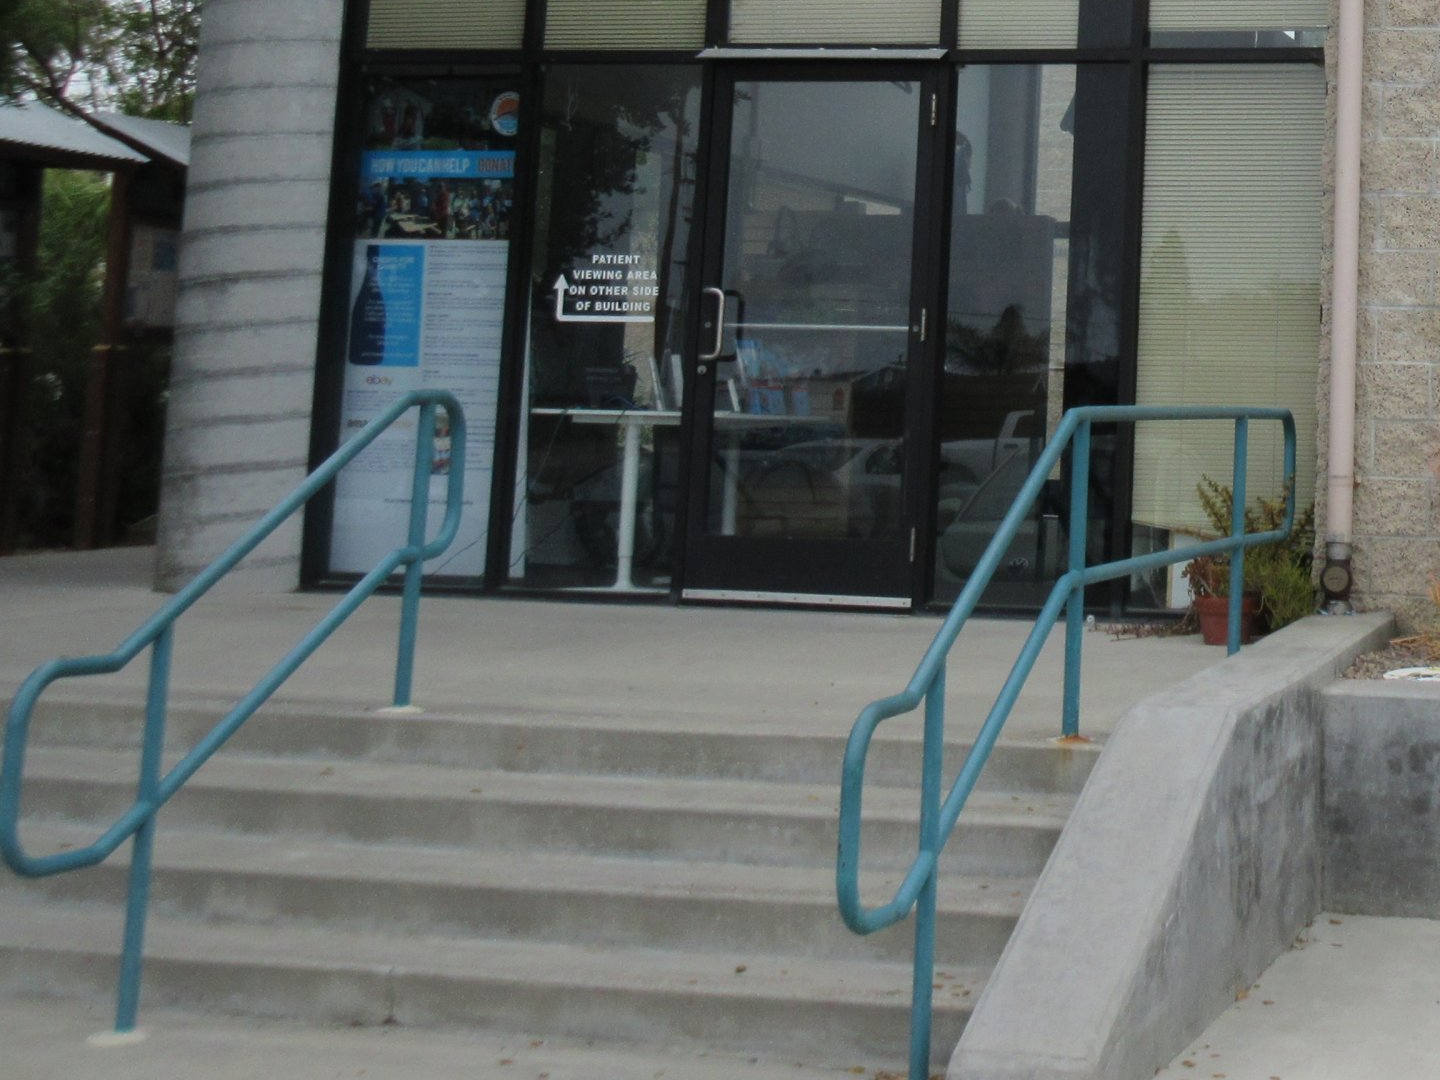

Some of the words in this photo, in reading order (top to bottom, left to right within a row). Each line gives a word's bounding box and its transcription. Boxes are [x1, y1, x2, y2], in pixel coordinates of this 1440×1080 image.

[592, 254, 641, 264] PATIENT
[573, 270, 623, 280] VIEWING
[627, 270, 658, 280] AREA
[569, 285, 586, 296] ON
[590, 286, 629, 296] OTHER
[632, 286, 660, 296] SIDE
[576, 301, 591, 311] OF
[595, 301, 651, 312] BUILDING
